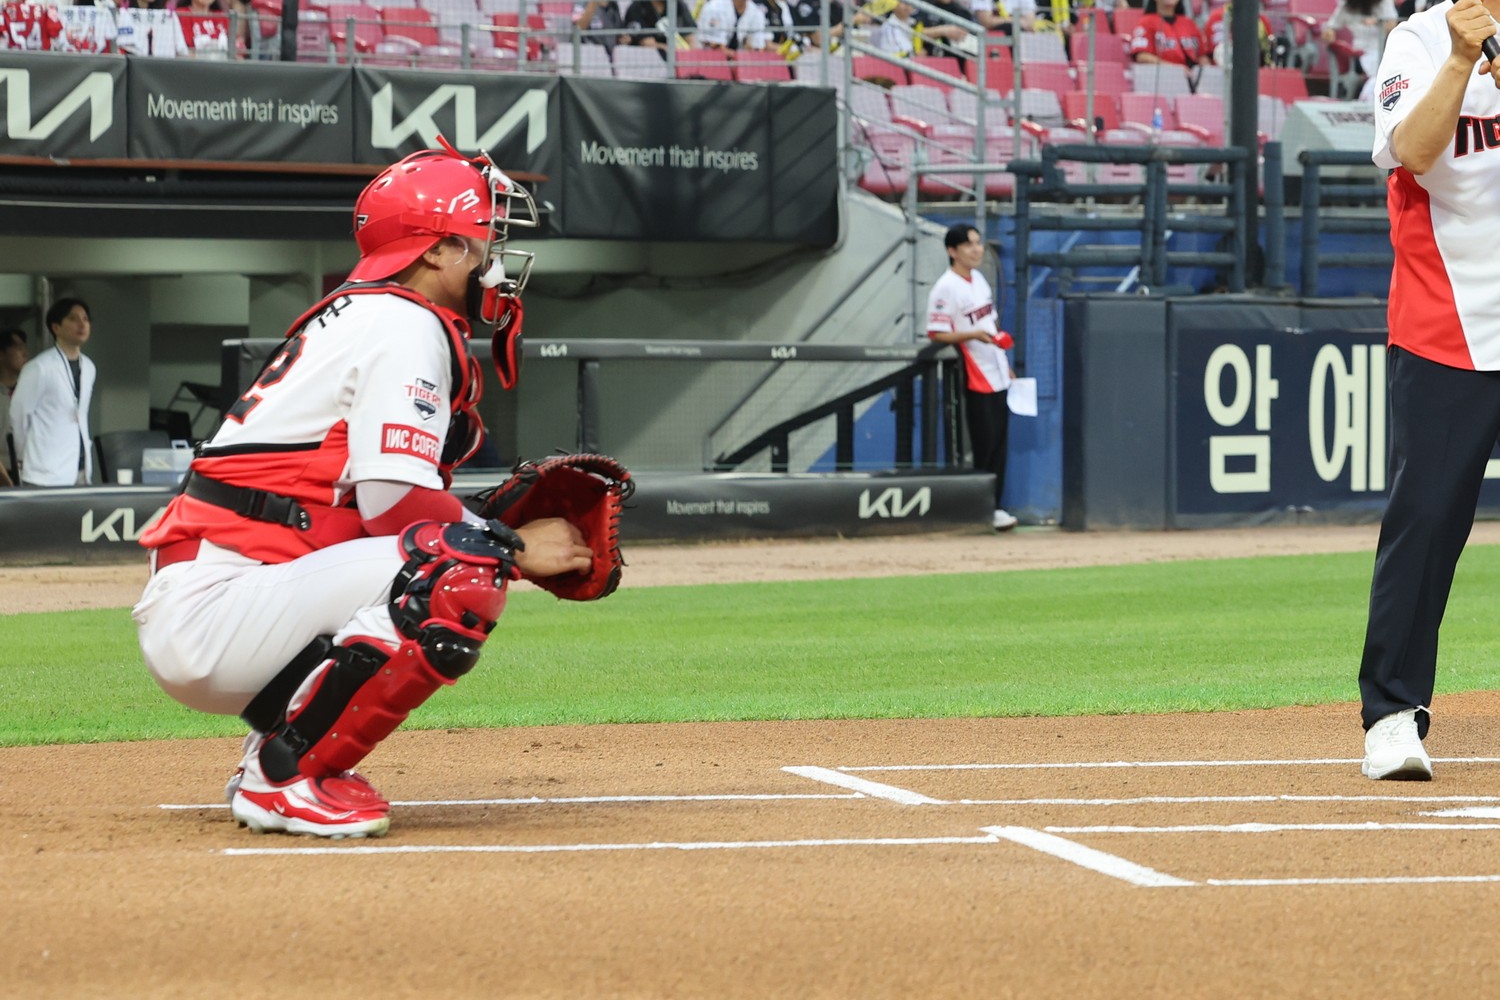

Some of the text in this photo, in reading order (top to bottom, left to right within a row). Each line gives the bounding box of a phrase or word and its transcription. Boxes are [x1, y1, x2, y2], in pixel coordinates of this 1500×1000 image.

[0, 68, 114, 143] IA
[1378, 78, 1411, 104] TIGERS
[147, 93, 339, 130] Movement that inspires
[371, 81, 548, 155] KIA
[581, 140, 759, 172] Movement that inspires
[539, 343, 568, 358] KIA
[770, 345, 798, 360] KIA
[1203, 342, 1279, 494] 암
[666, 499, 770, 517] Movement that inspires
[858, 486, 931, 519] KIA
